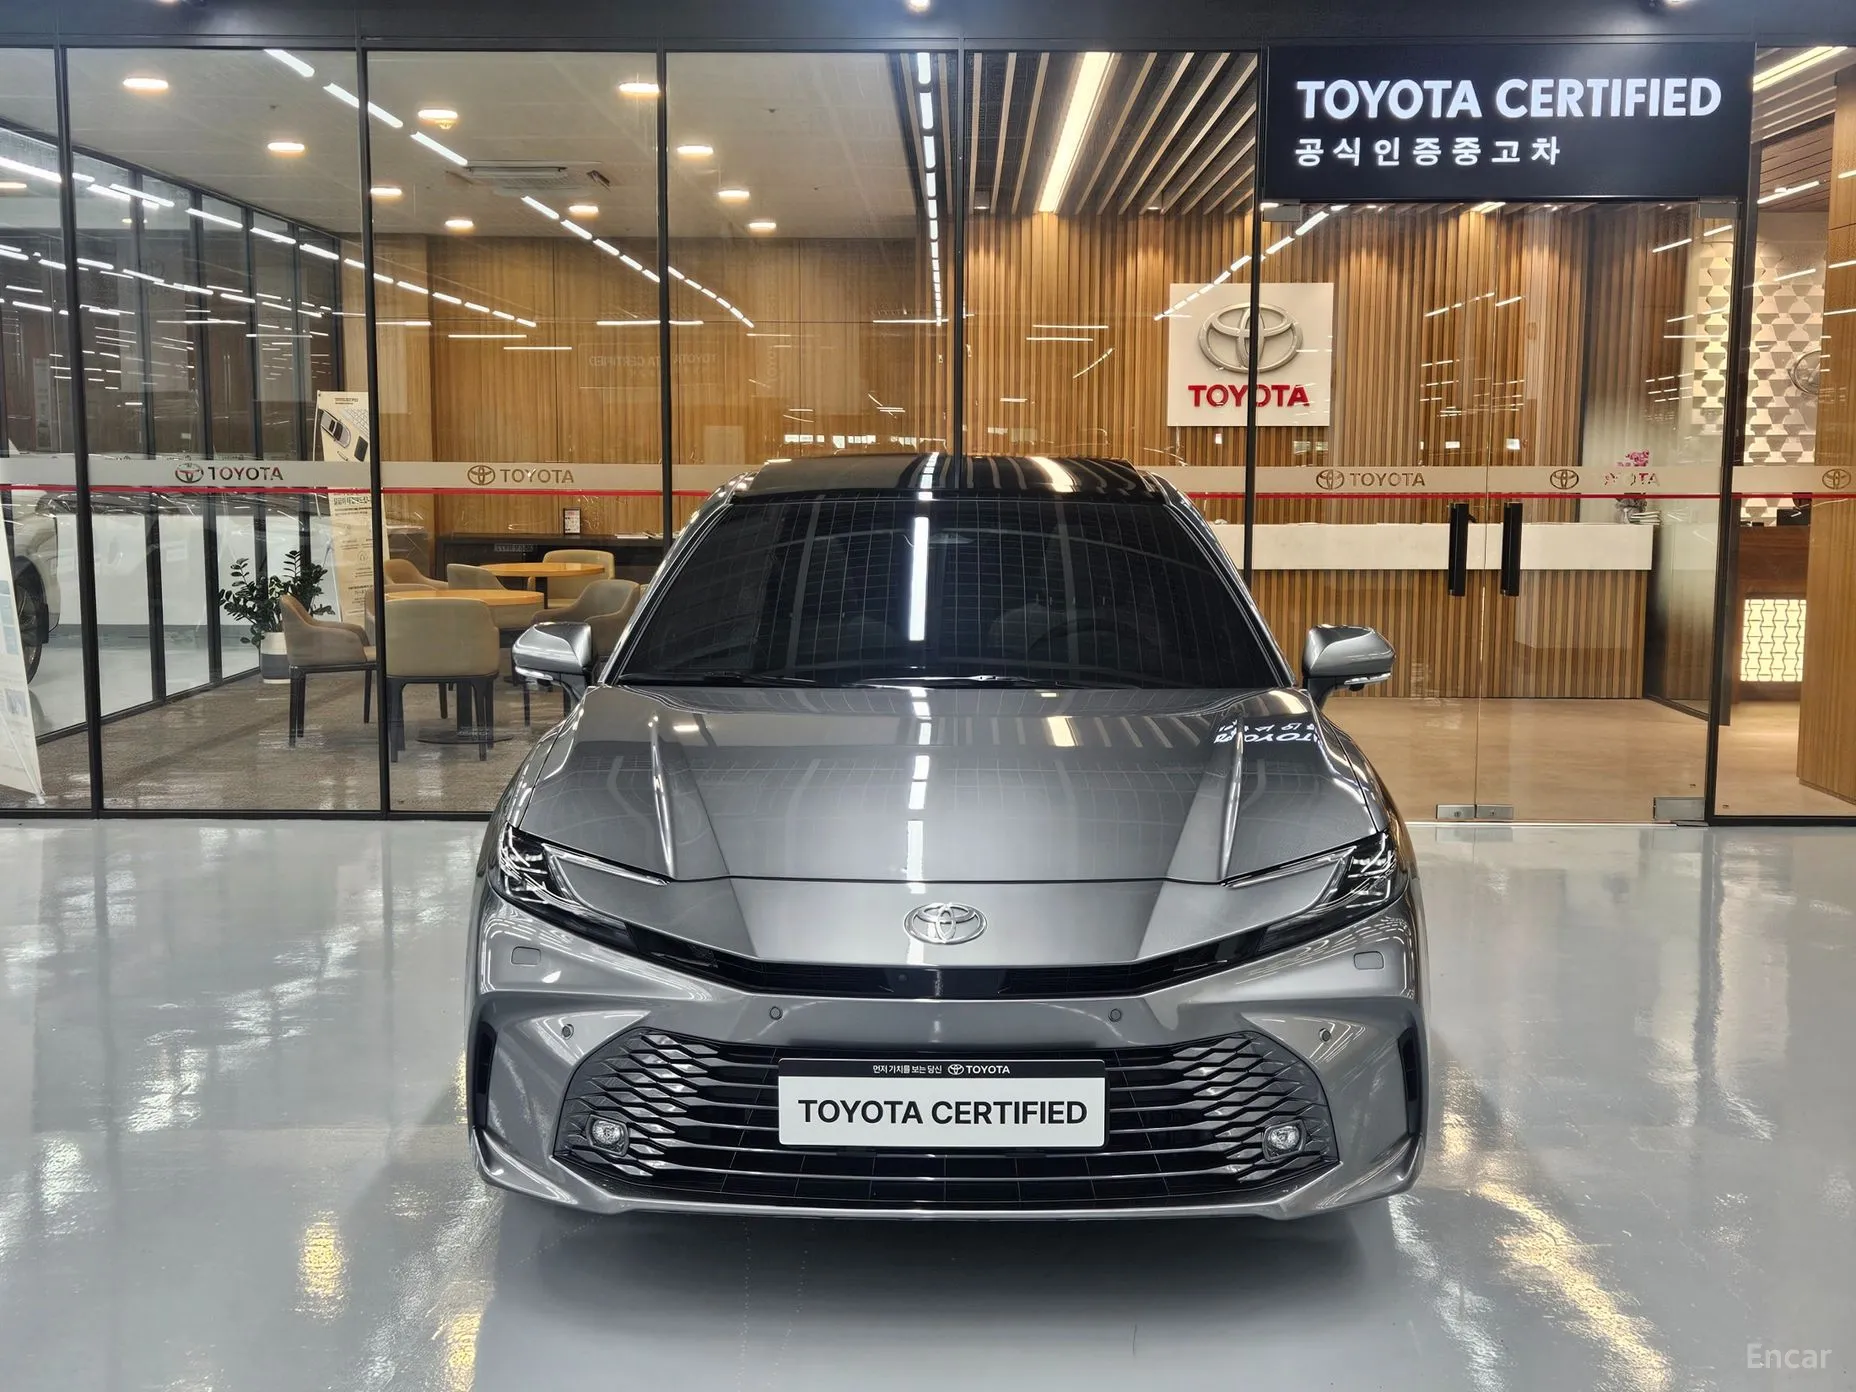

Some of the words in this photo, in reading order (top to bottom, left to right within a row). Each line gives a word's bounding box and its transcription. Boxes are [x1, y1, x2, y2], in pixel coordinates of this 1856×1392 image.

[1296, 79, 1482, 119] TOYOTA
[1495, 77, 1722, 118] CERTIFIED
[1187, 384, 1311, 408] TOYOTA
[207, 466, 284, 481] TOYOTA
[499, 468, 575, 484] TOYOTA
[1349, 472, 1426, 487] TOYOTA
[872, 1064, 888, 1074] 먼저
[888, 1064, 911, 1074] 가치를
[911, 1064, 927, 1074] 보는
[927, 1064, 942, 1074] 당신
[965, 1065, 1011, 1074] TOYOTA
[797, 1099, 924, 1125] TOYOTA
[930, 1100, 1088, 1125] CERTIFIED
